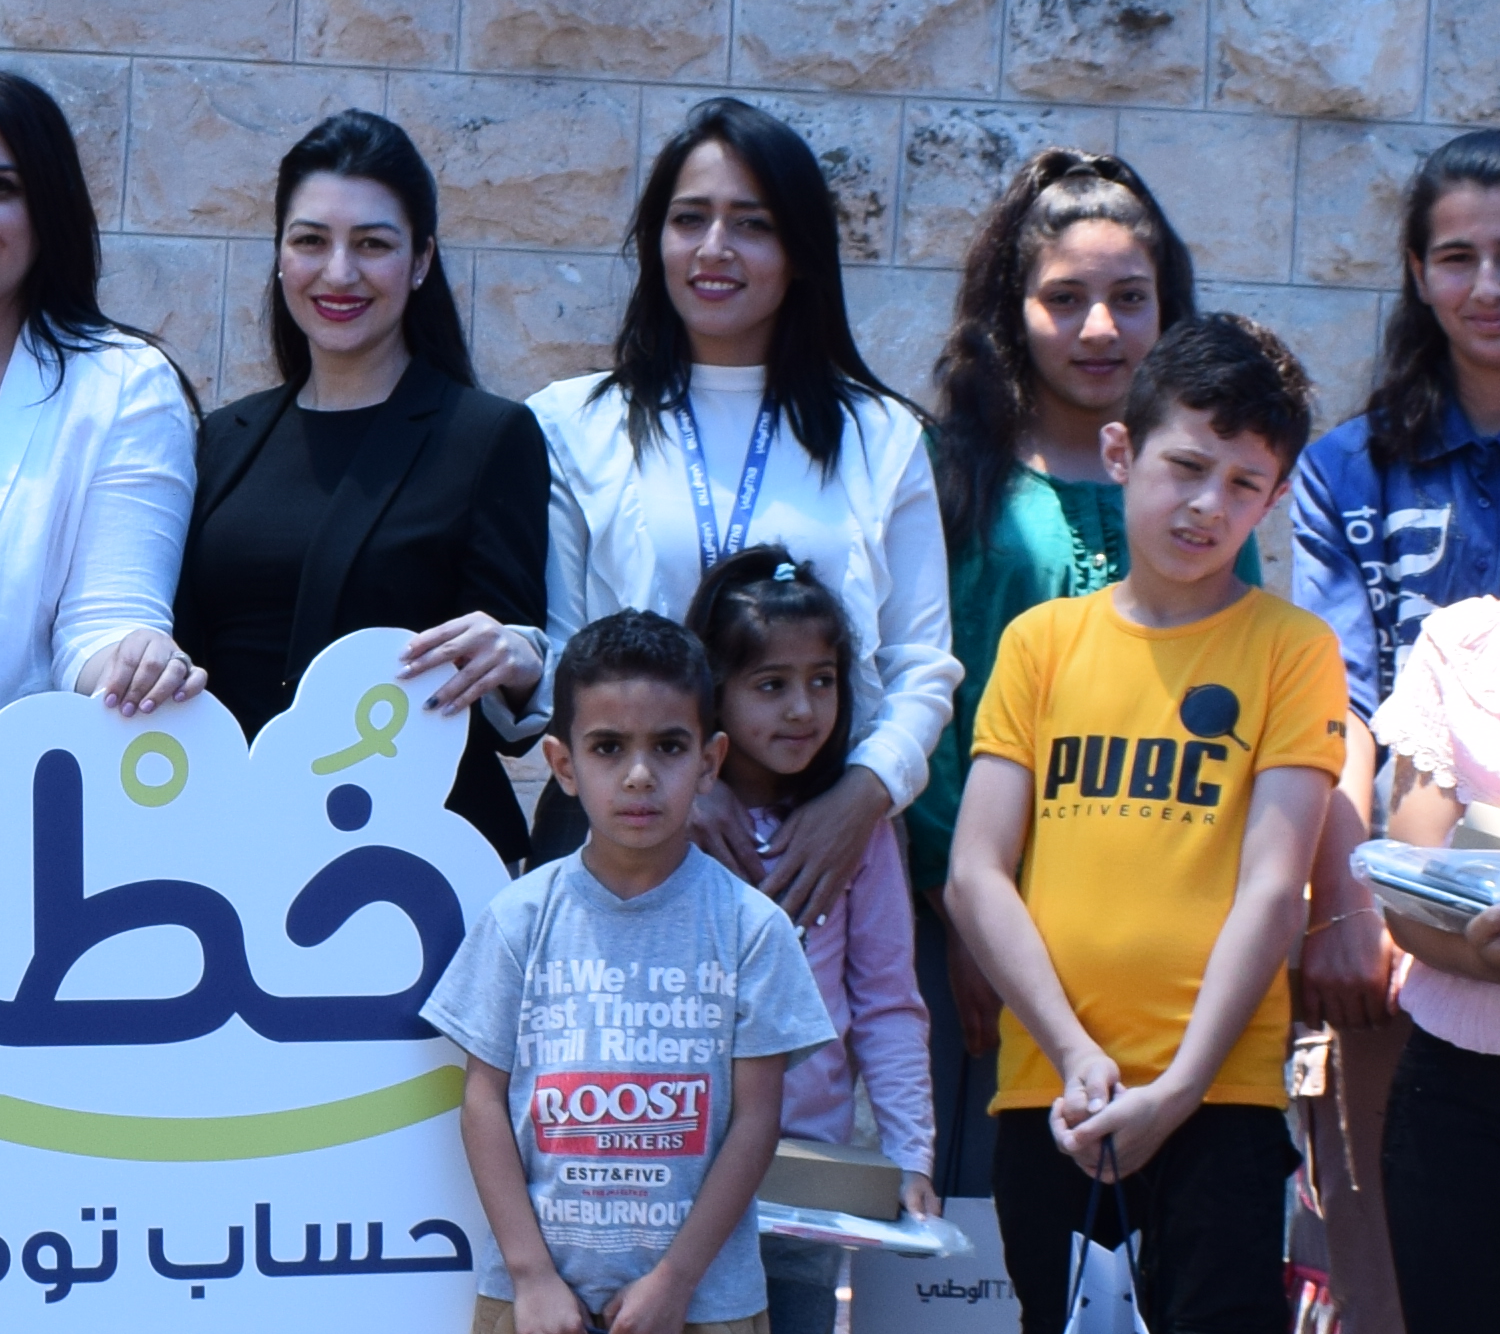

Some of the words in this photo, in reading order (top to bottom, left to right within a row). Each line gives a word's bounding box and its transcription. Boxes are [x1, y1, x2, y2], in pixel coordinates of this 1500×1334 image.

[1342, 505, 1377, 545] to
[1044, 735, 1228, 807] PUBG
[1040, 803, 1217, 826] ACTIVEGEAR
[697, 960, 738, 998] the
[518, 1029, 586, 1067] Thrill
[535, 1079, 707, 1125] ROOST
[597, 1133, 685, 1151] BIKERS
[148, 1202, 474, 1300] حساب
[914, 1278, 991, 1305] الوطني
